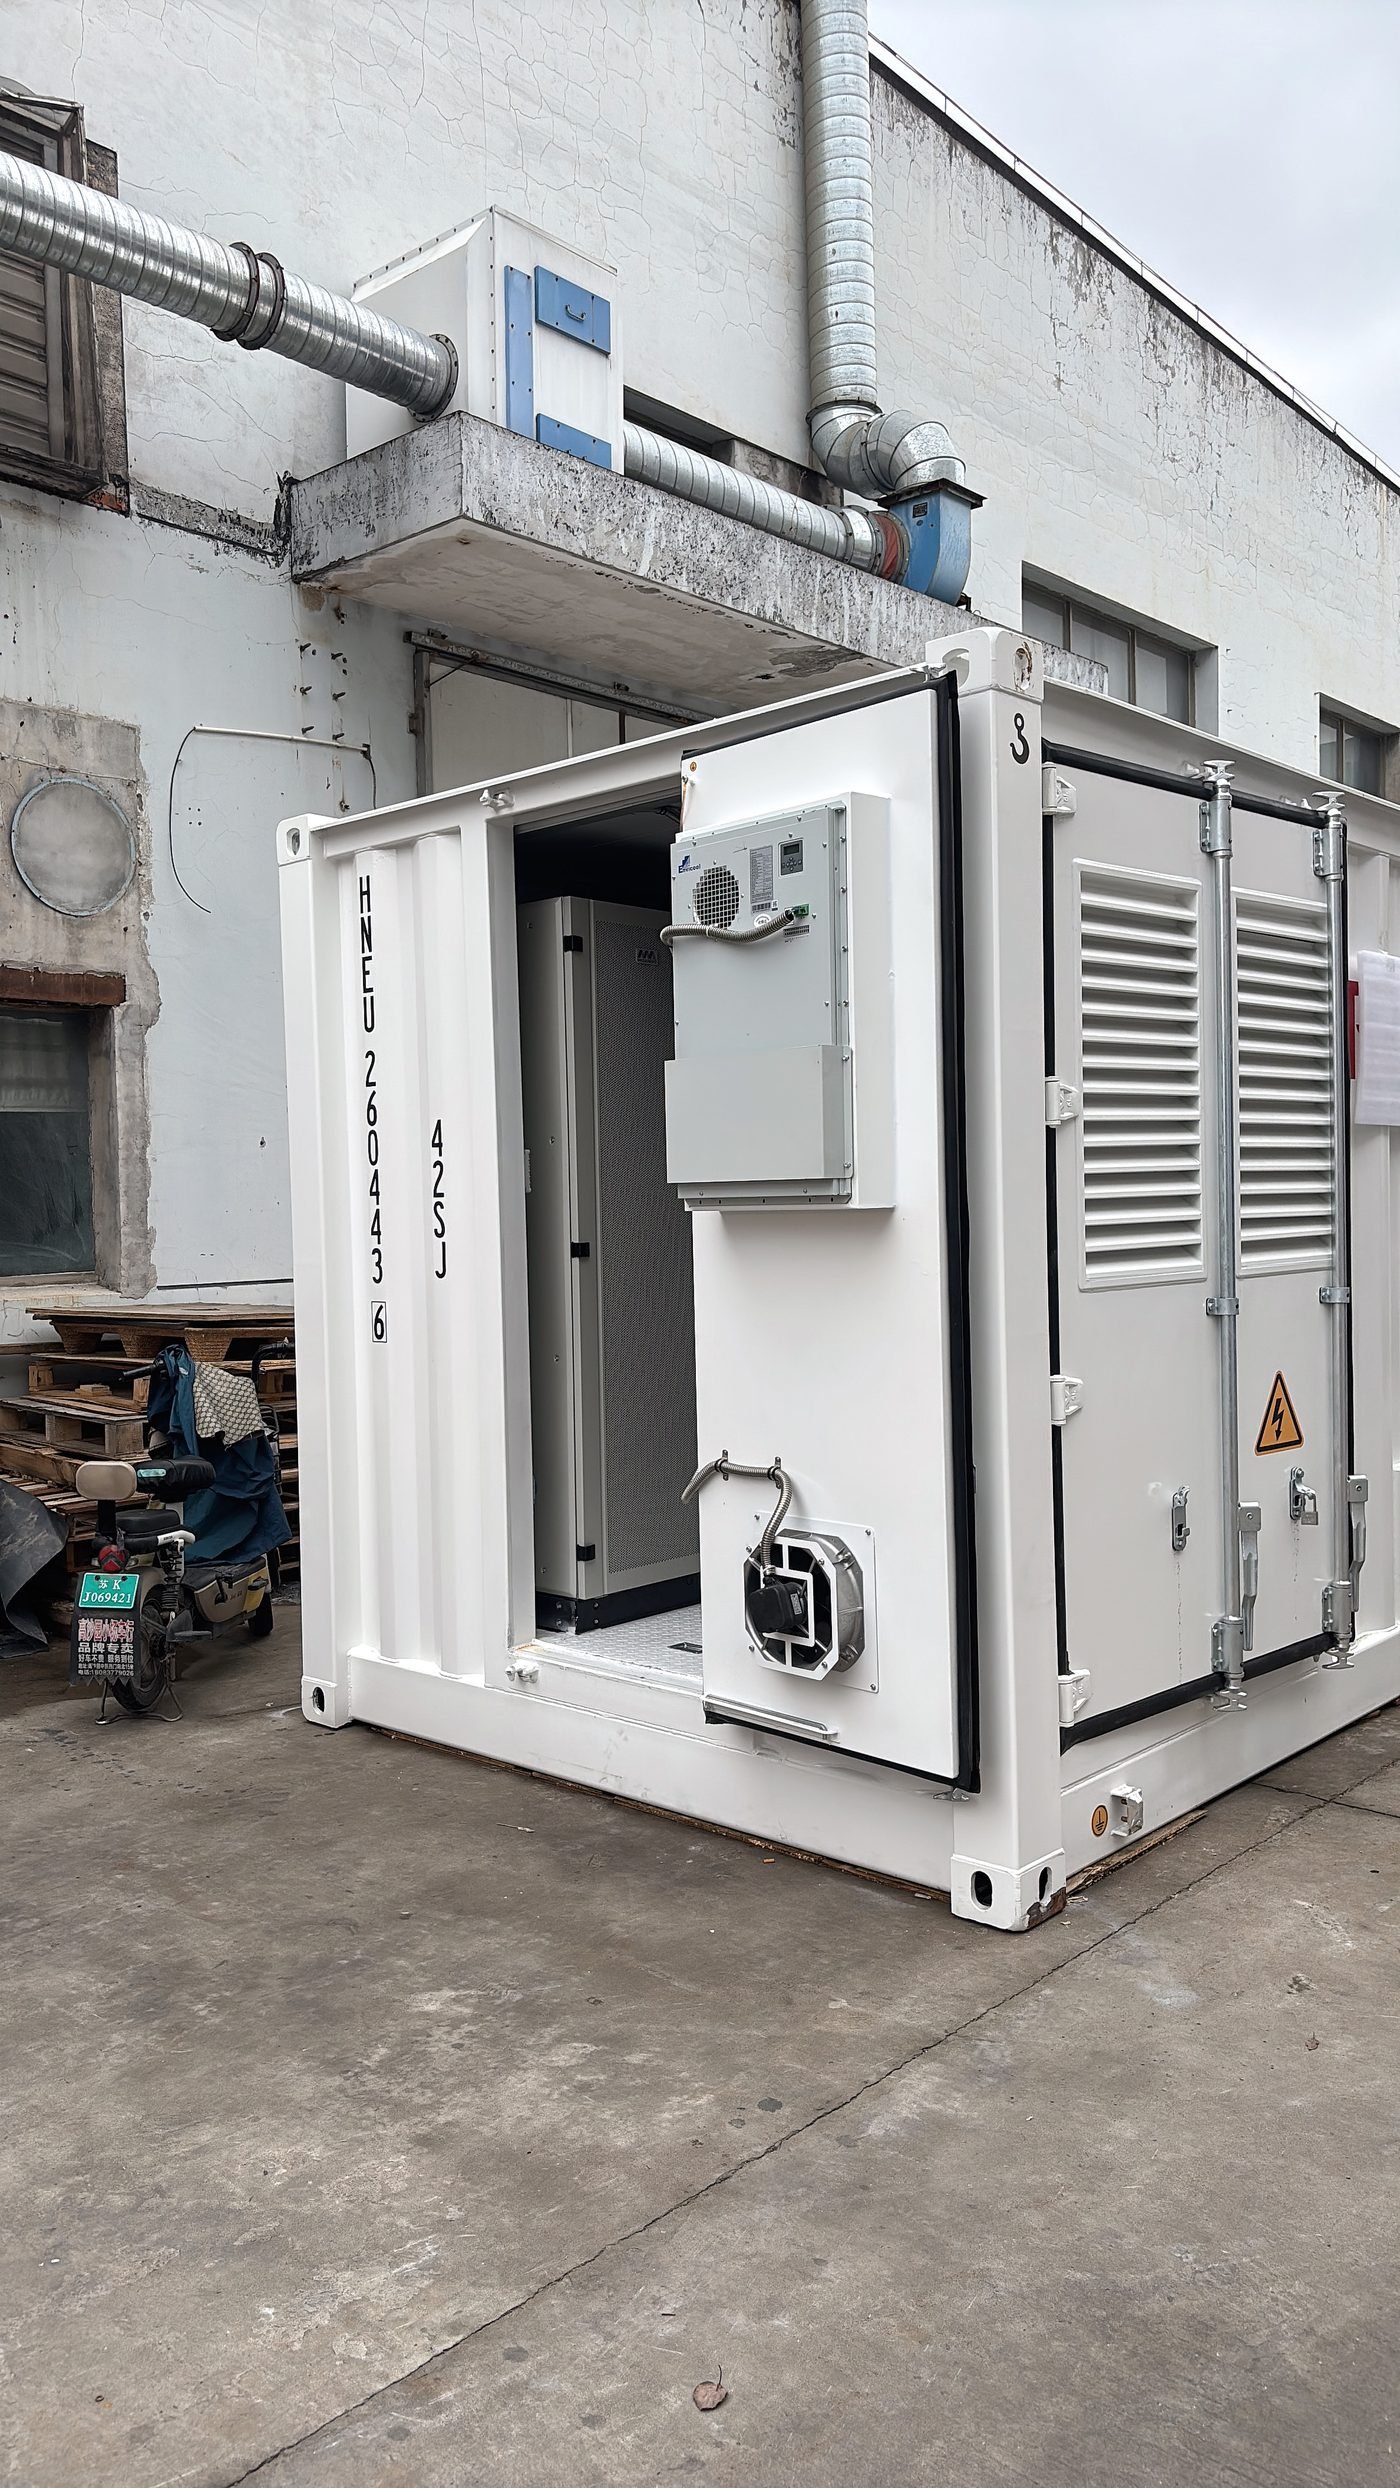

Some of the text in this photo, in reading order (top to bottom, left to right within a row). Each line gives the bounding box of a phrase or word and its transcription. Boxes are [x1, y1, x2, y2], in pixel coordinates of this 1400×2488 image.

[359, 875, 386, 1341] HNEU 260443 6
[431, 1119, 447, 1279] 42SJ
[98, 1579, 122, 1590] 苏 K
[82, 1592, 131, 1603] J069421
[78, 1642, 134, 1654] 品牌专卖
